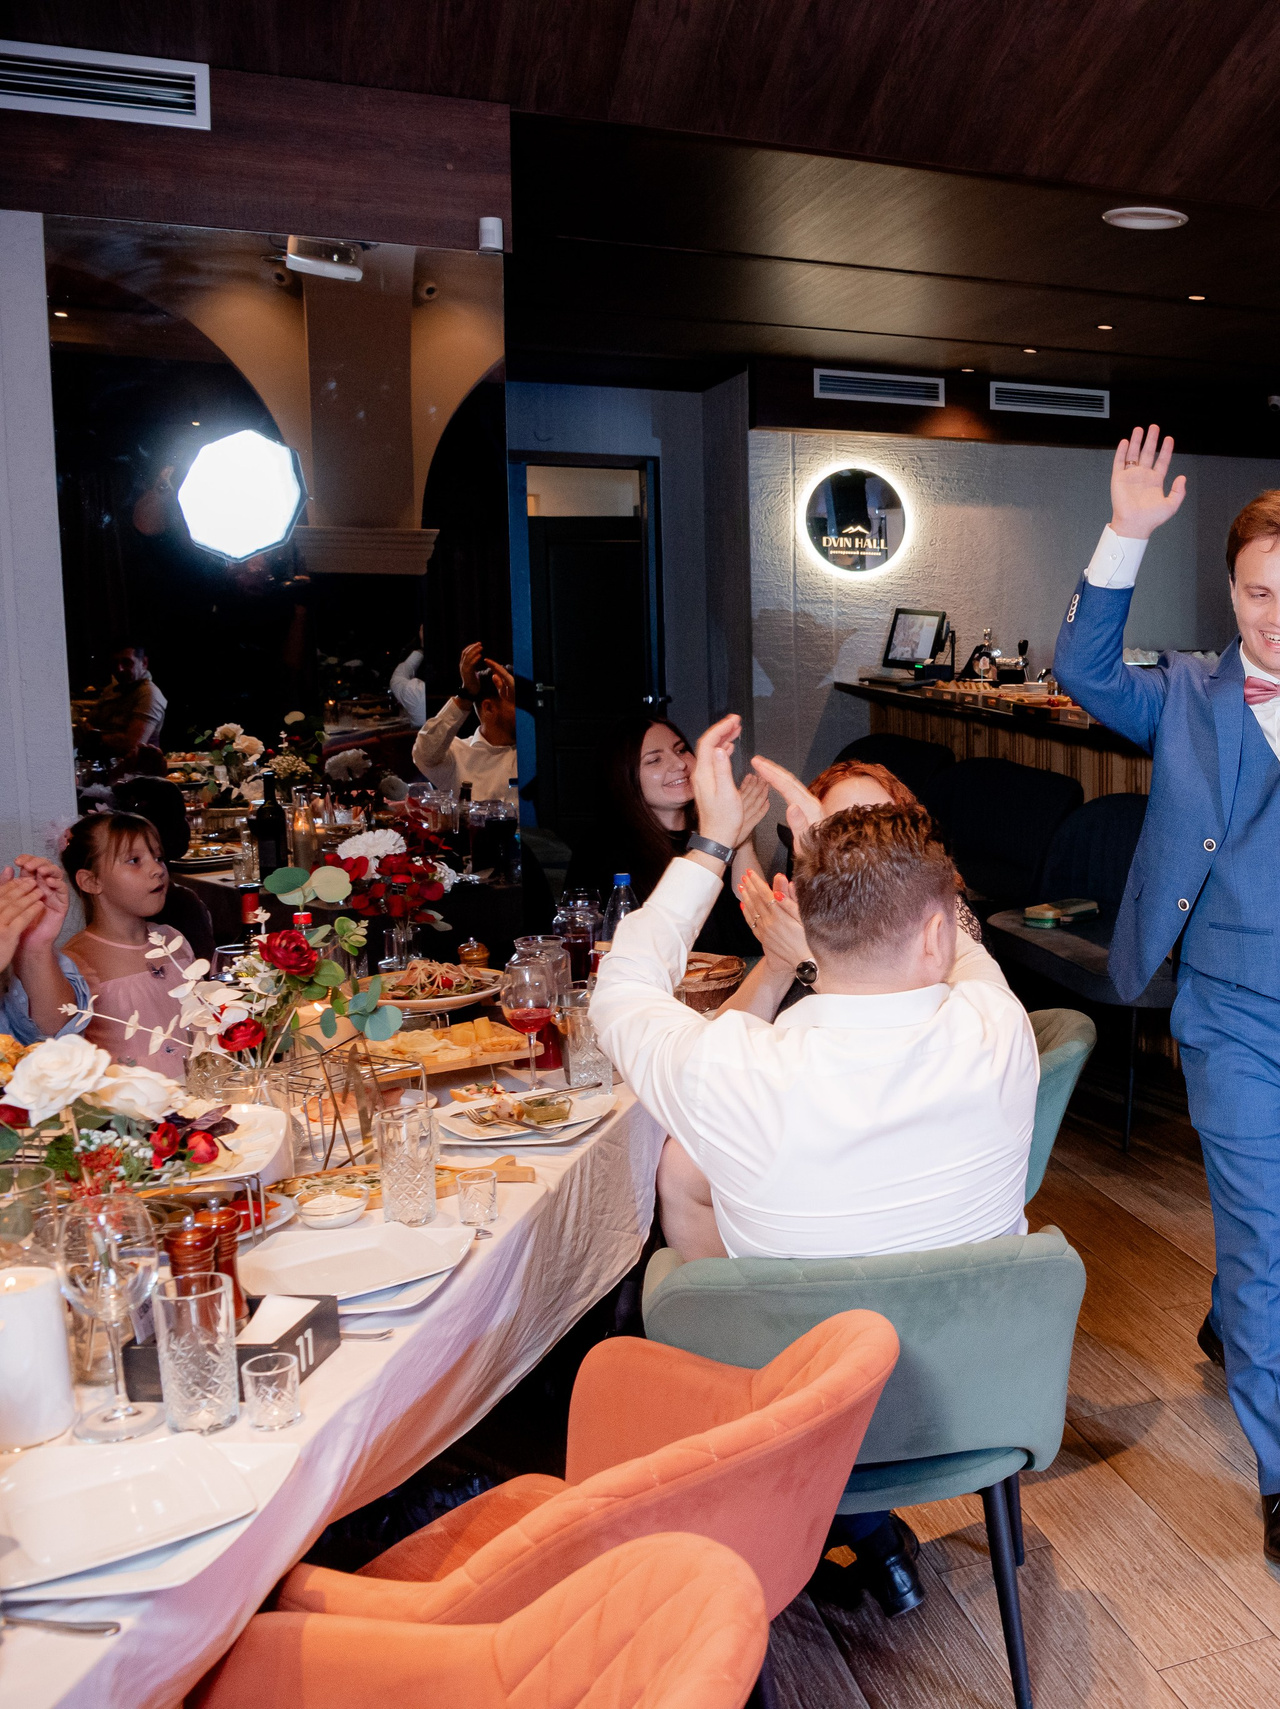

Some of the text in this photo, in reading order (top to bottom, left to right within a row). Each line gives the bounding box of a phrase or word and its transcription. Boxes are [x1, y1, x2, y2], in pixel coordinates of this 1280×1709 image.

[822, 536, 888, 549] DVIN HALL
[295, 1328, 314, 1372] 11
